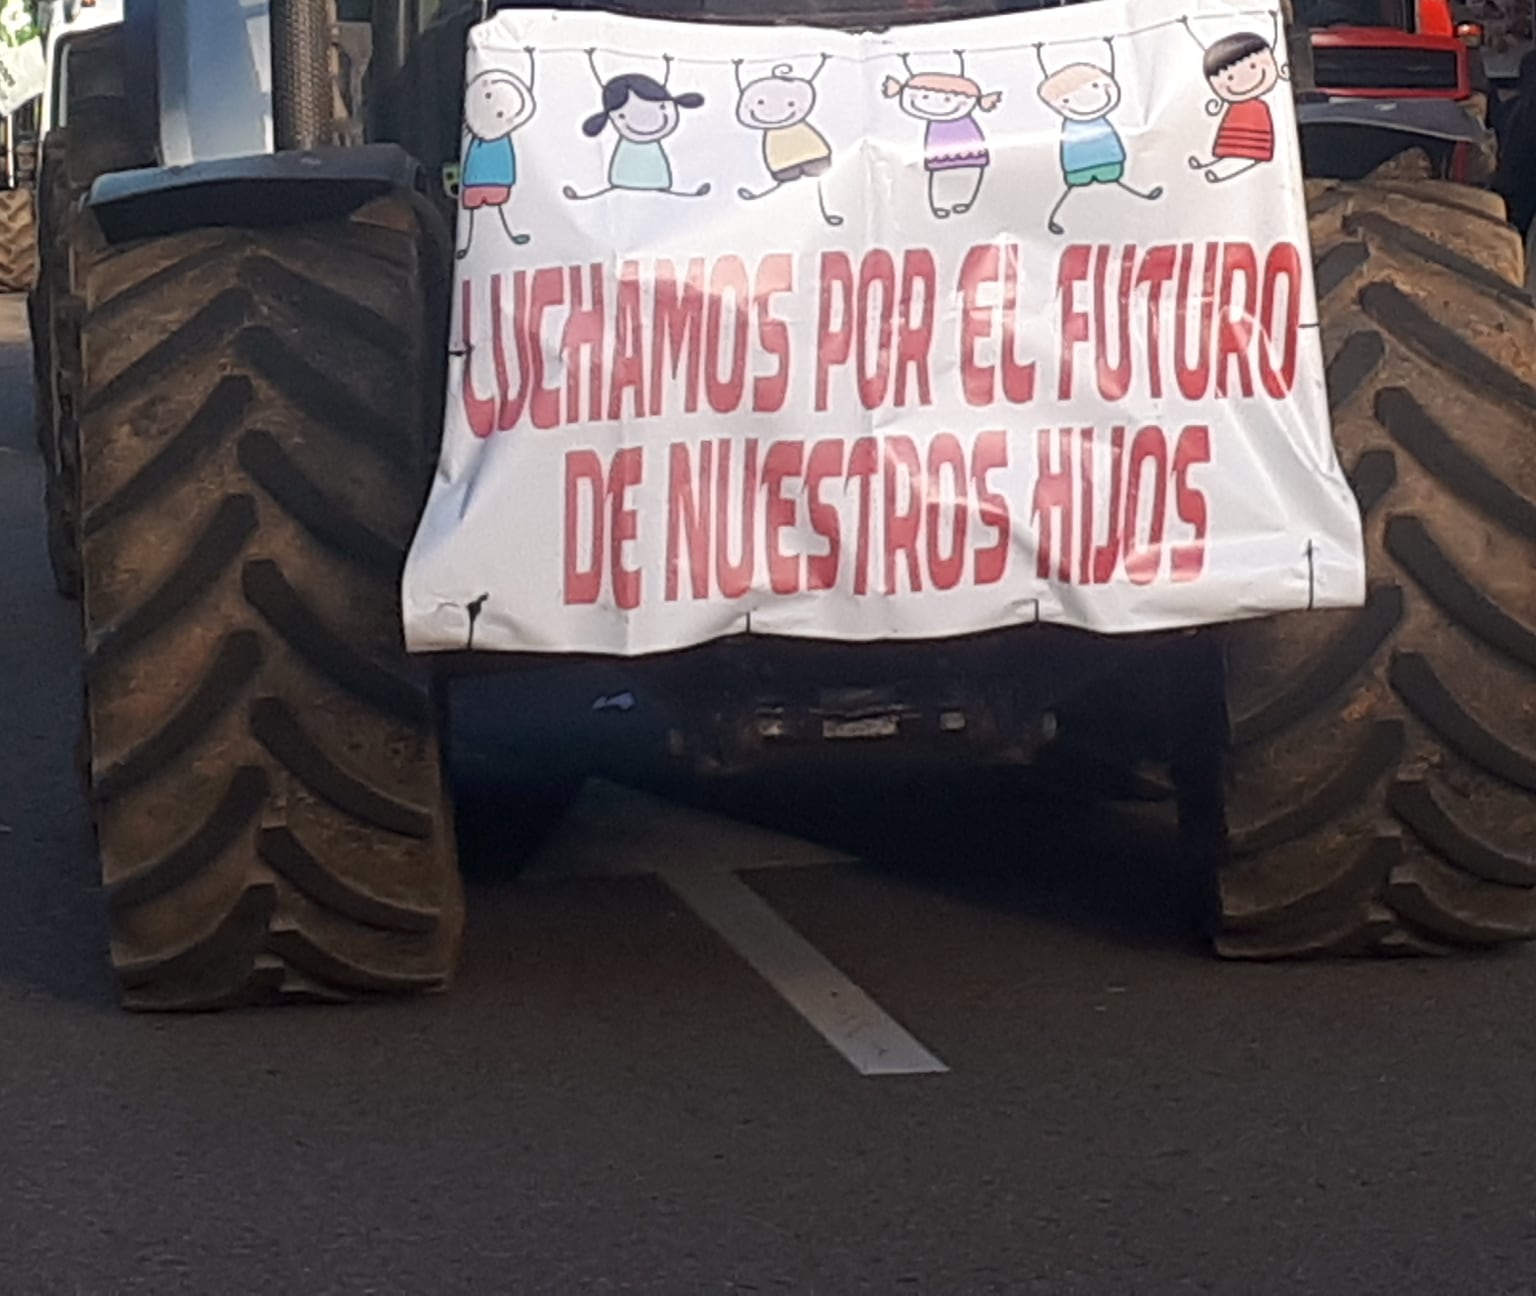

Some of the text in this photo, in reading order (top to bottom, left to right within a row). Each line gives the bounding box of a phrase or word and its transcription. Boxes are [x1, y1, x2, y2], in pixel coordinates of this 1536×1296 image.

[461, 240, 1301, 439] LUCHAMOS POR EL FUTURO
[563, 424, 1212, 609] DE NUESTROS HIJOS
